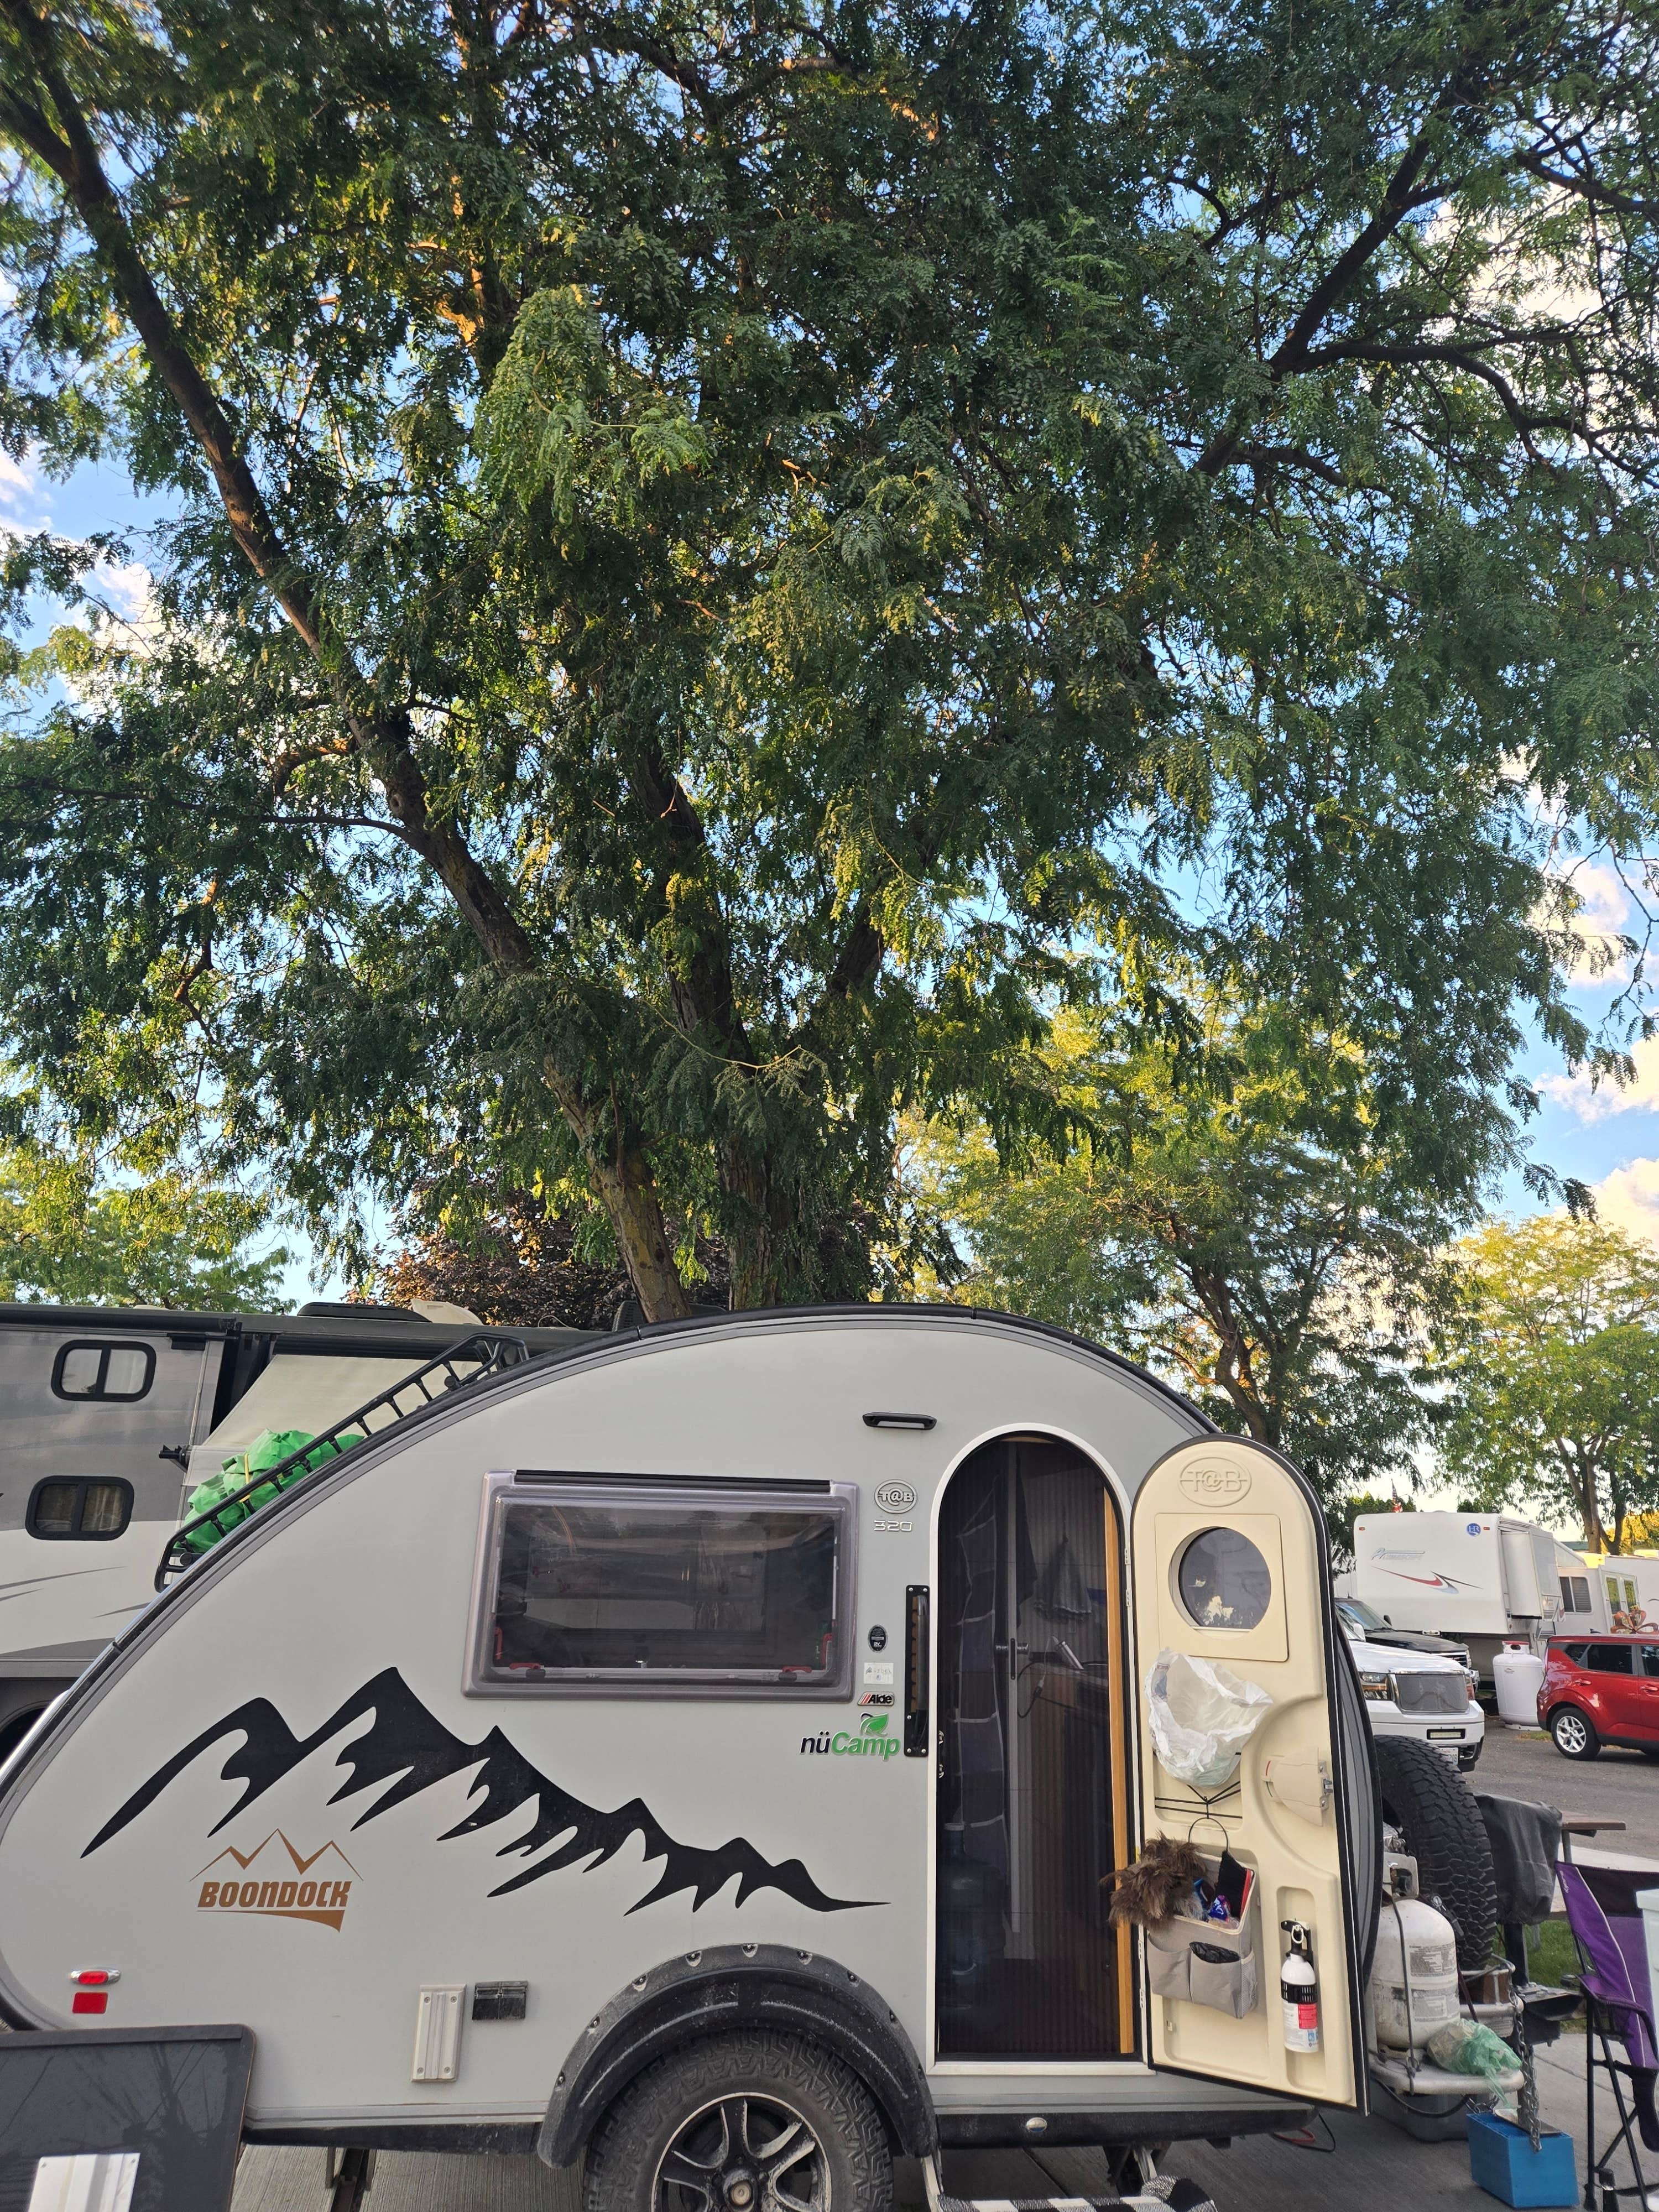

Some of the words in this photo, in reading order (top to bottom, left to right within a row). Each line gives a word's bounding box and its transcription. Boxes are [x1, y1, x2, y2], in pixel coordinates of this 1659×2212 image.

[1187, 1470, 1242, 1492] T@B
[878, 1487, 914, 1506] T@B
[874, 1520, 912, 1531] 320
[800, 1730, 901, 1761] nüCamp
[197, 1881, 352, 1908] BOONDOCK
